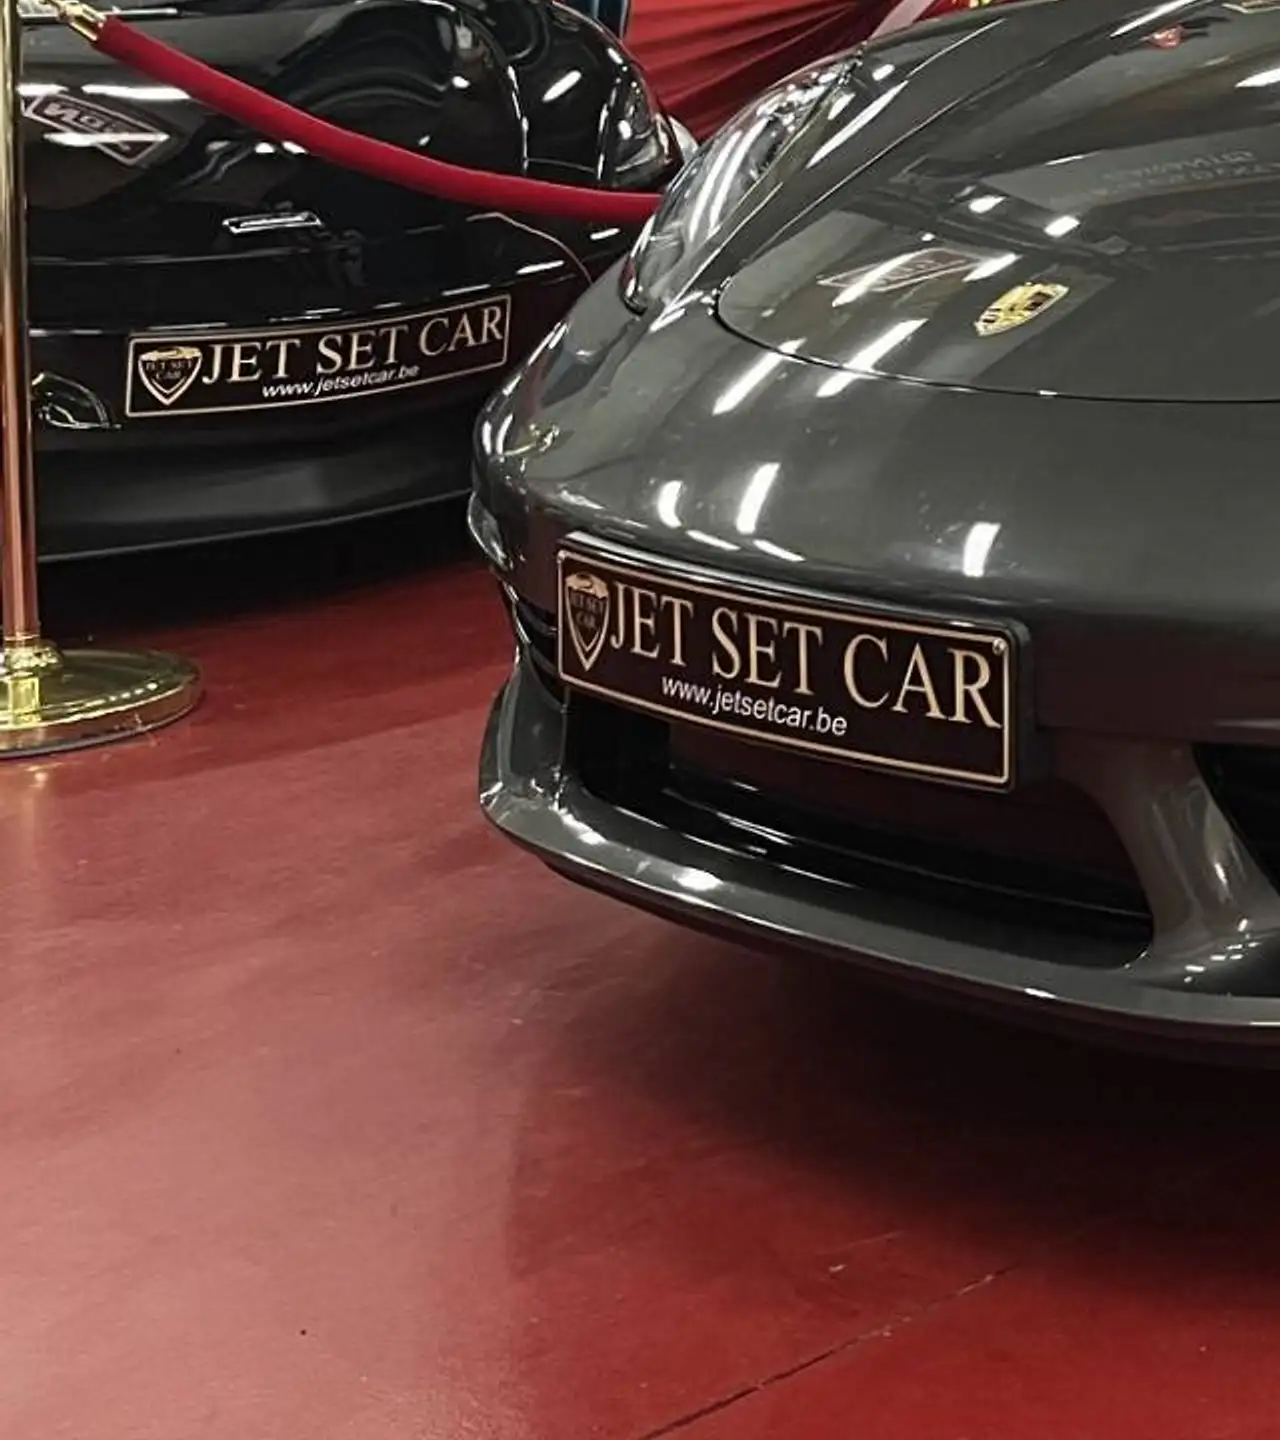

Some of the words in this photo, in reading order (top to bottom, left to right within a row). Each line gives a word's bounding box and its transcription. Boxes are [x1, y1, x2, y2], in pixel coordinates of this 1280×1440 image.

[201, 339, 301, 386] JET
[315, 326, 409, 375] SET
[418, 305, 504, 357] CAR
[261, 363, 421, 398] www.jetsetcar.be
[610, 581, 694, 667] JET
[711, 607, 823, 696] SET
[843, 632, 1003, 728] CAR
[661, 675, 848, 736] www.jetsetcar.be
